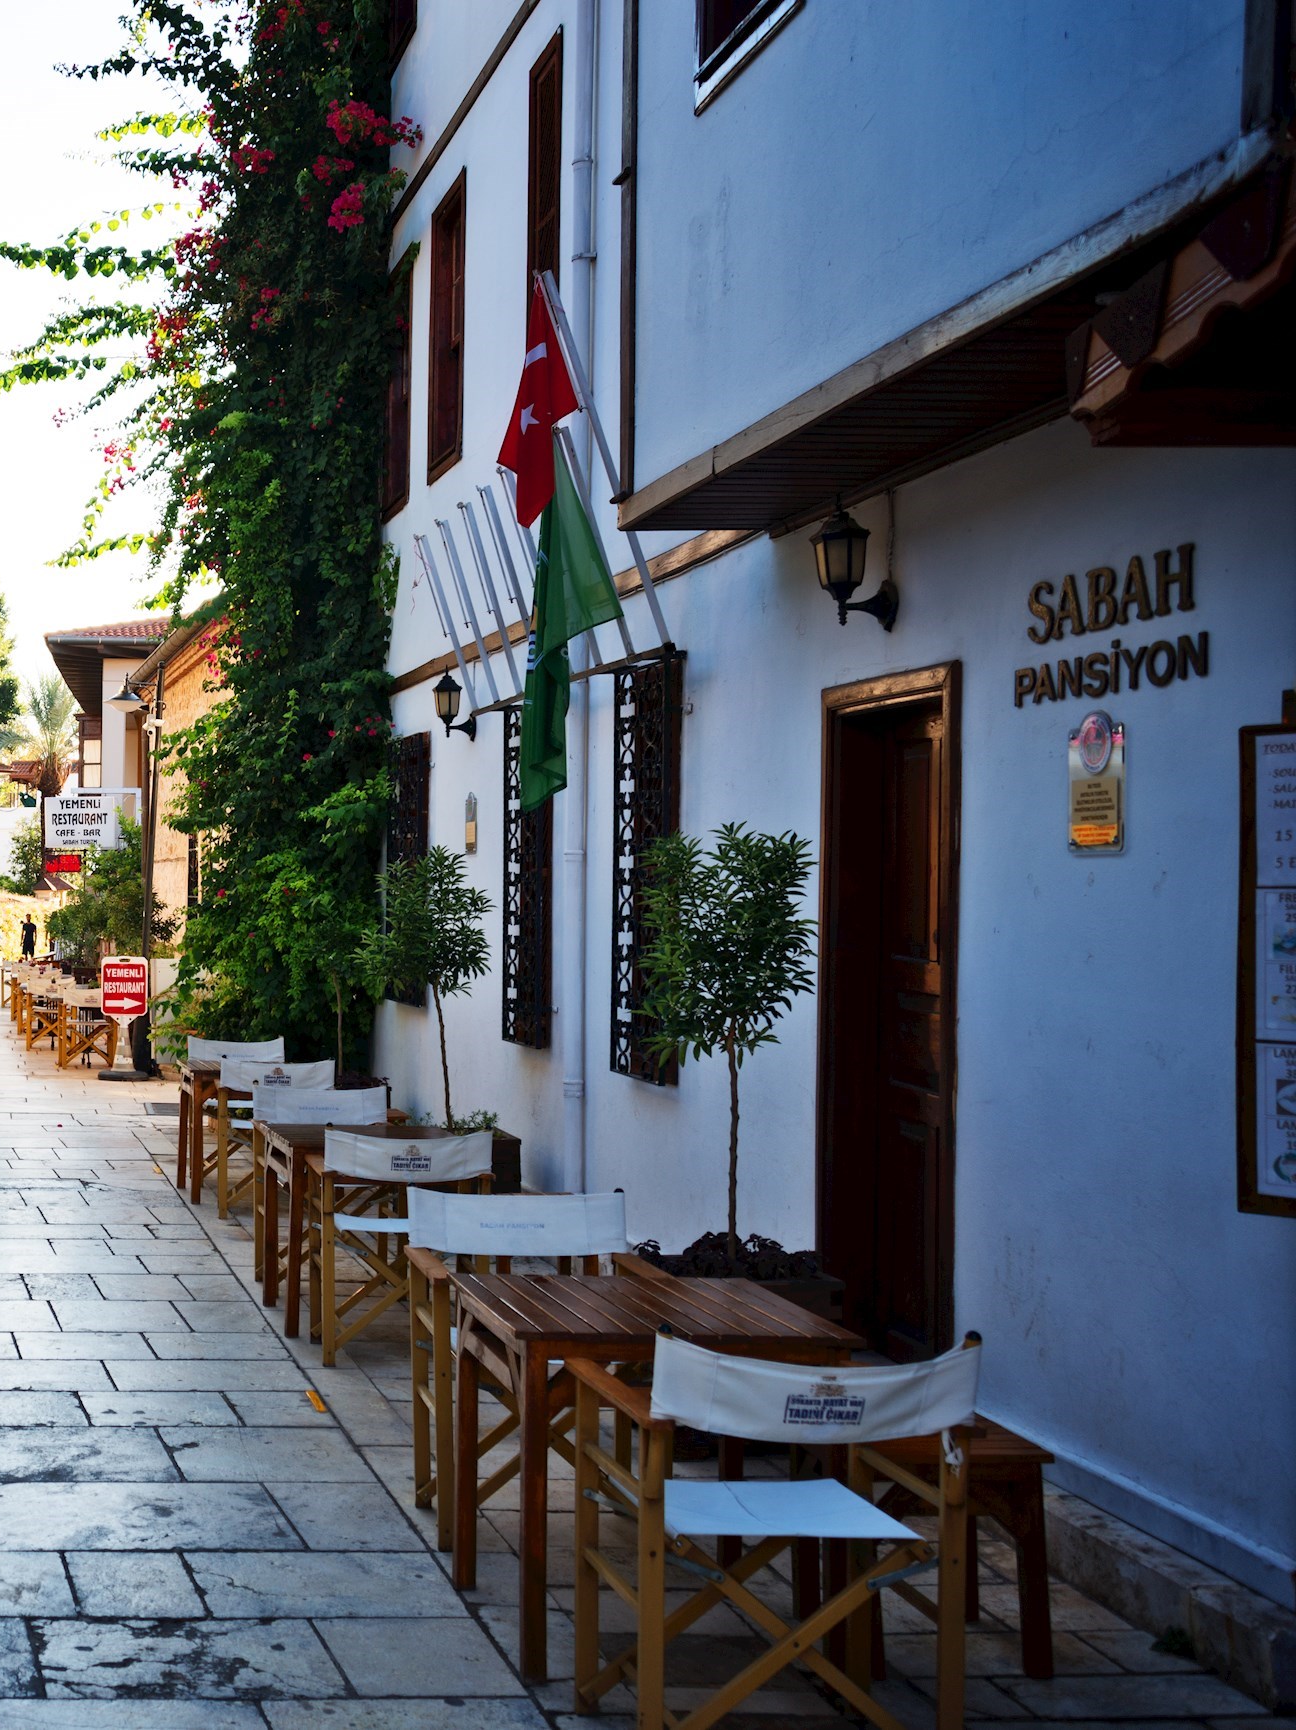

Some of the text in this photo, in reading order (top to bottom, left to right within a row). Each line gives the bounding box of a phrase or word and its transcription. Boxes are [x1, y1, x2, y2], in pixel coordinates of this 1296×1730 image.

[1027, 542, 1195, 645] SABAH
[1014, 630, 1210, 707] PANSİYON
[51, 812, 108, 826] RESTAURANT
[55, 829, 75, 837] CAFE
[83, 828, 101, 837] BAR
[104, 982, 144, 993] RESTAURANT
